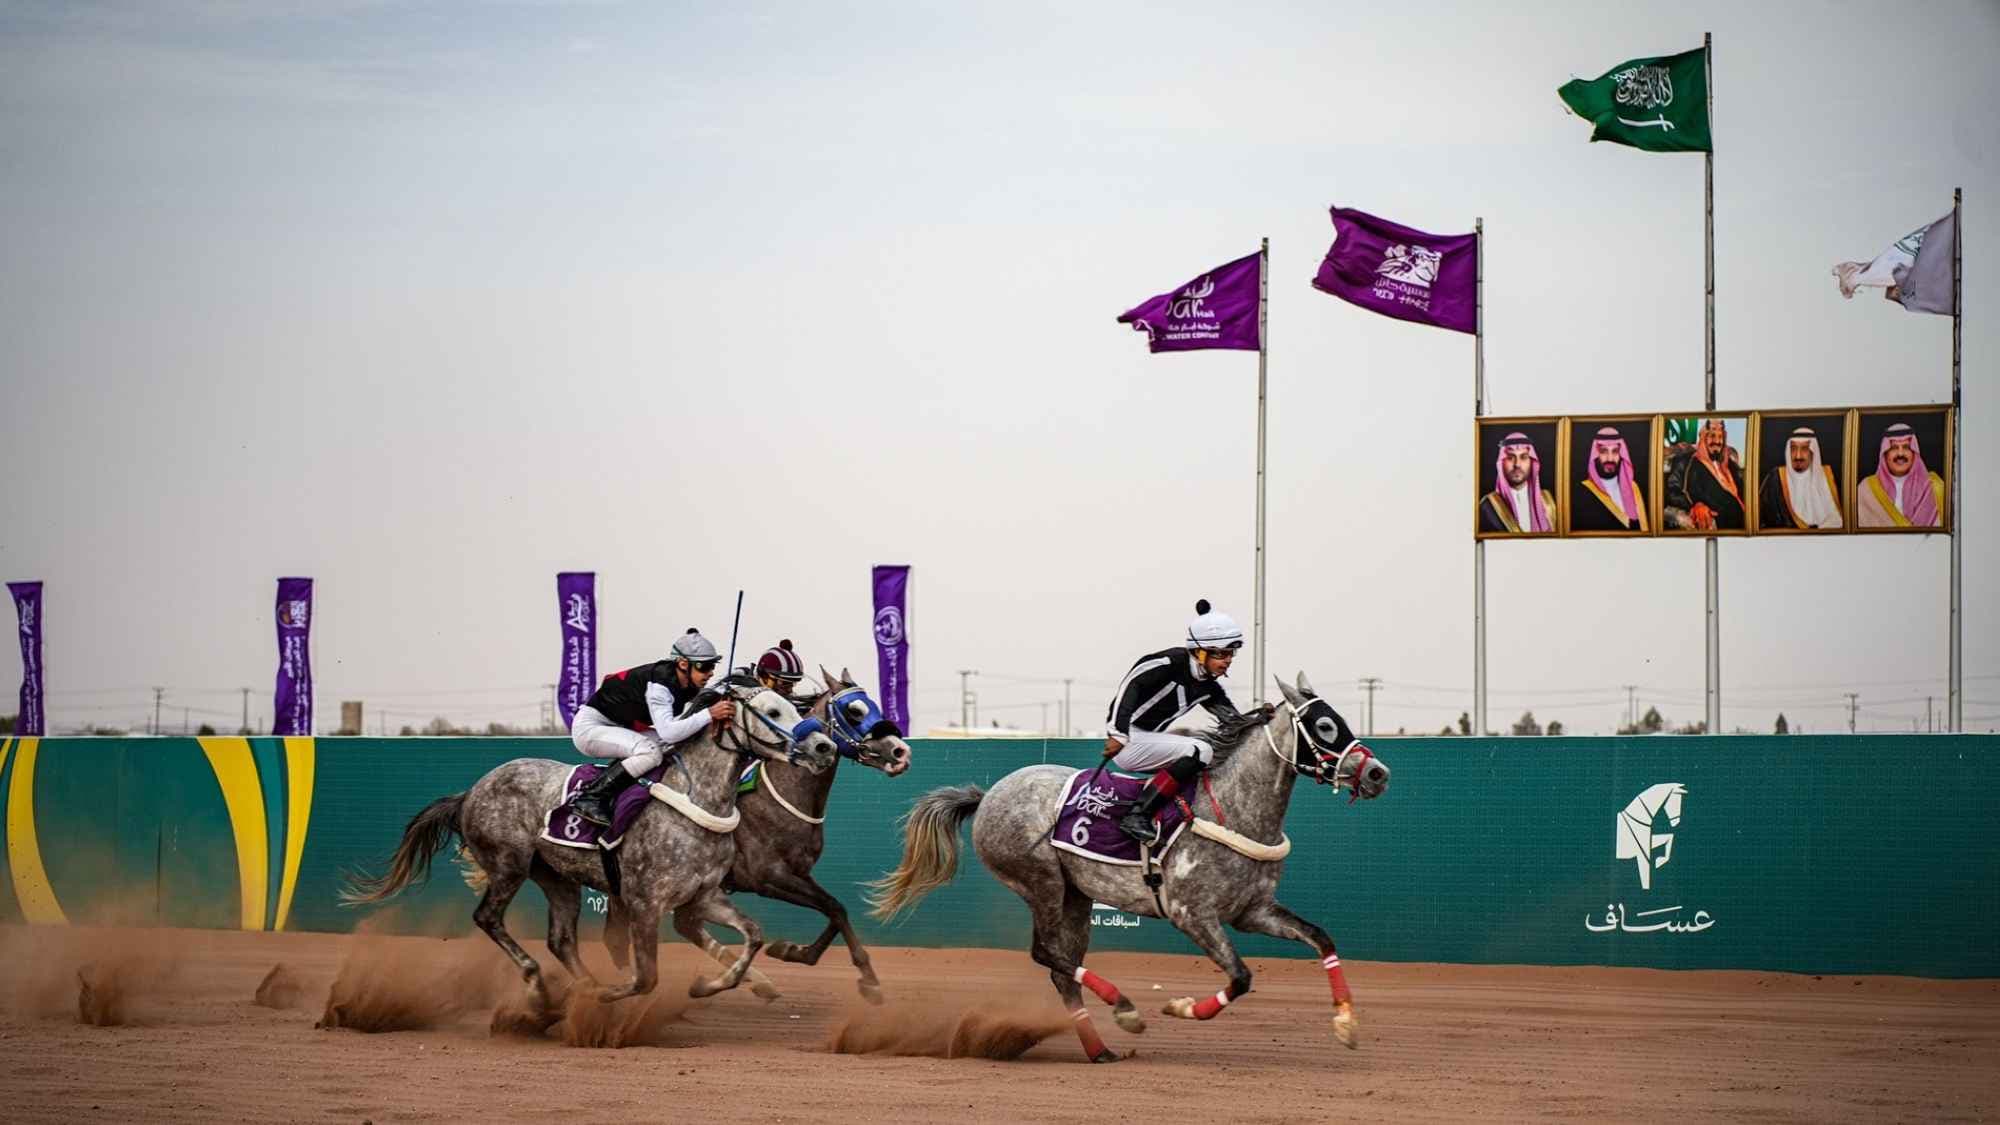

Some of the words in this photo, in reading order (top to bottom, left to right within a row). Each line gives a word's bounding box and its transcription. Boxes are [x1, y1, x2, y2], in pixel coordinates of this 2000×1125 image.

[564, 814, 582, 839] 8
[1071, 816, 1093, 847] 6
[1102, 914, 1140, 929] لسباقات
[1584, 903, 1716, 933] عساف
